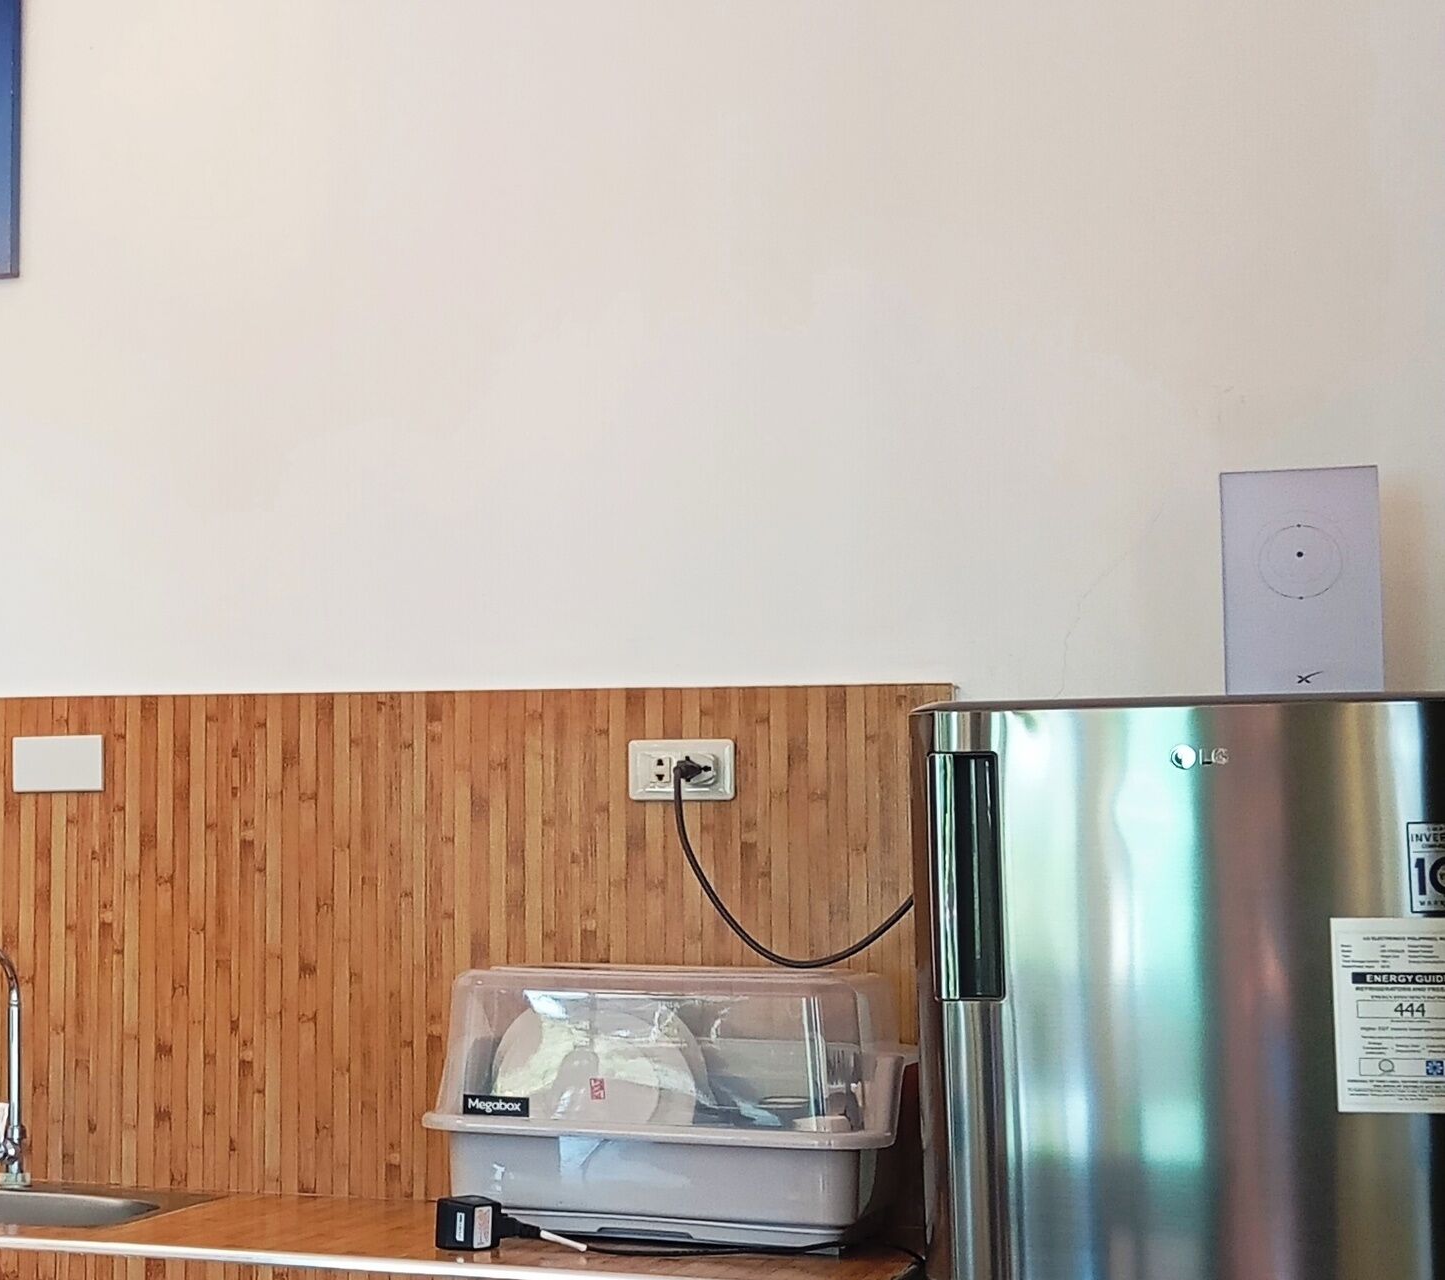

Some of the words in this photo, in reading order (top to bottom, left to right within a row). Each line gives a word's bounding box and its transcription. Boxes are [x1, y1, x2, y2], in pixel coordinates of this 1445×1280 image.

[1365, 974, 1414, 983] ENERGY
[1415, 974, 1445, 984] GUID
[1394, 1003, 1426, 1017] 444
[468, 1098, 522, 1112] Megabox
